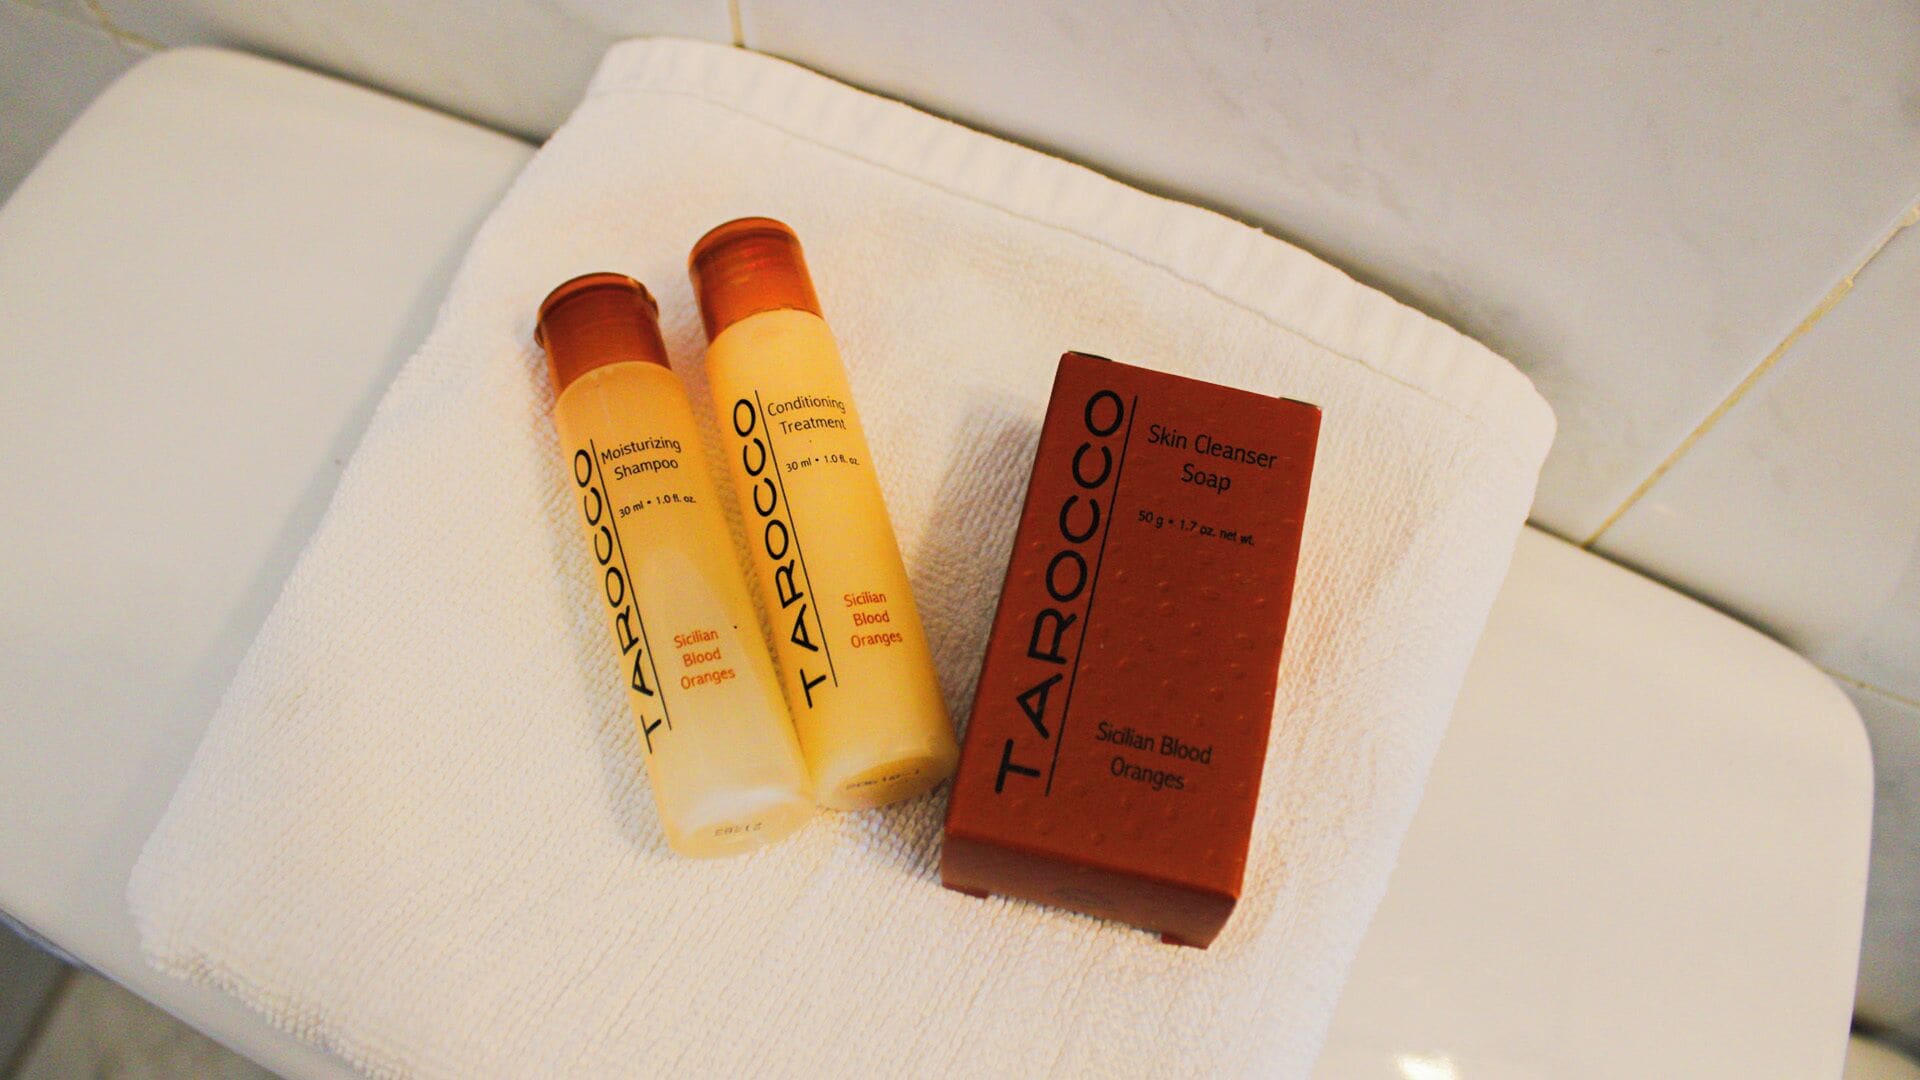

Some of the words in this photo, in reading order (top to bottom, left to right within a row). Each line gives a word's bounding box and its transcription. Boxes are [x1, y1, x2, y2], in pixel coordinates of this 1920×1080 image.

[768, 395, 846, 417] Conditioning
[780, 416, 846, 435] Treatment
[601, 436, 681, 465] Moisturizing
[1148, 424, 1187, 450] Skin
[1194, 434, 1278, 468] Cleanser
[614, 458, 679, 480] Shampoo
[786, 461, 798, 472] 30
[801, 457, 811, 468] ml
[824, 454, 838, 464] 1.0
[1181, 463, 1231, 494] Soap
[619, 506, 631, 519] 30
[633, 501, 644, 512] ml
[656, 494, 671, 505] 1.0
[1138, 510, 1153, 523] 50
[1155, 516, 1164, 528] g
[1180, 519, 1197, 532] 1.7
[1200, 526, 1216, 537] oz.
[1219, 529, 1237, 542] net
[733, 399, 827, 709] TAROCCO
[574, 449, 662, 754] TAROCCO
[843, 591, 887, 608] Sicilian
[995, 390, 1124, 794] TAROCCO
[852, 610, 890, 627] Blood
[674, 629, 719, 649] Sicilian
[851, 631, 903, 649] Oranges
[683, 648, 722, 668] Blood
[680, 667, 736, 690] Oranges
[1096, 721, 1154, 751] Sicilian
[1160, 735, 1212, 765] Blood
[1110, 756, 1185, 791] Oranges
